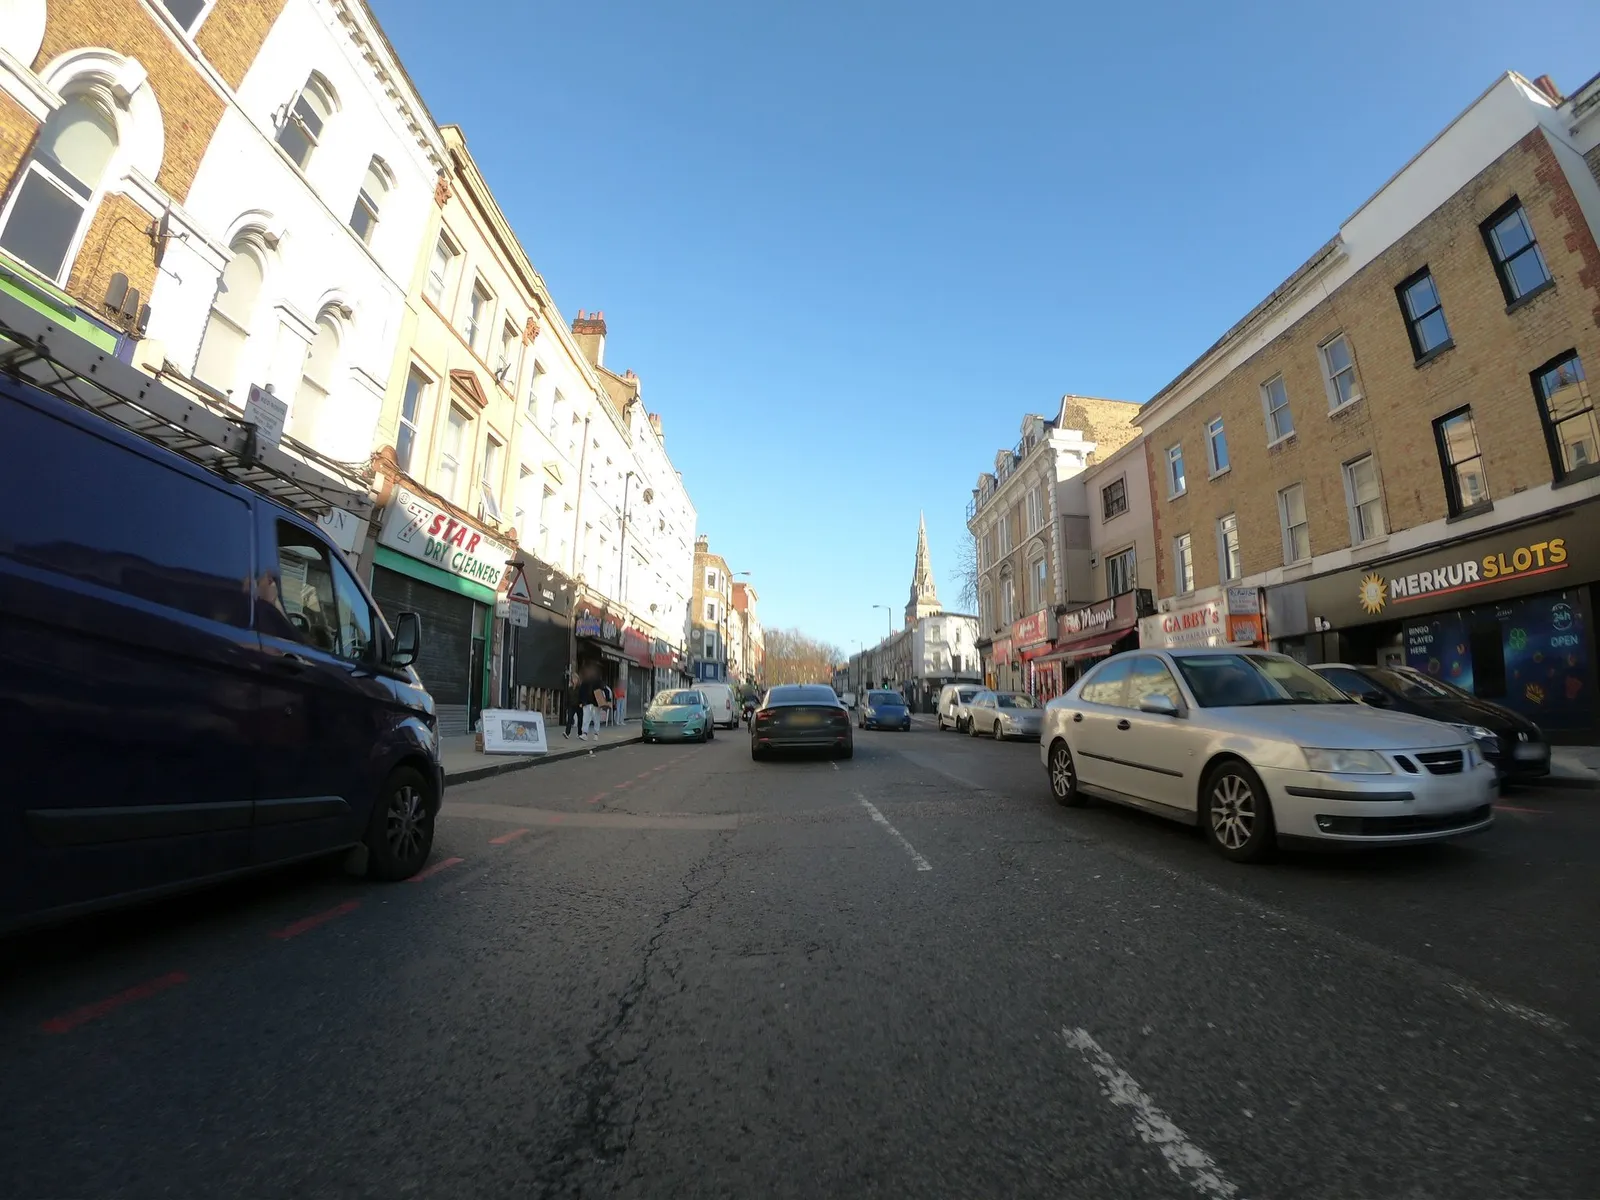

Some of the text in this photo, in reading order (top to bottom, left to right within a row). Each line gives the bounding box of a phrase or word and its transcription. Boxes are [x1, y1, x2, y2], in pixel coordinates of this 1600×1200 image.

[397, 503, 434, 544] 7
[428, 514, 481, 553] STAR
[424, 536, 450, 563] DRY
[452, 551, 501, 585] CLEANERS
[1390, 538, 1568, 599] MERKUR SLOTS
[1080, 599, 1116, 631] Mangal
[1408, 625, 1429, 636] BINGO
[1409, 634, 1434, 645] PLAYED
[1551, 634, 1578, 648] OPEN
[1410, 645, 1427, 655] HERE
